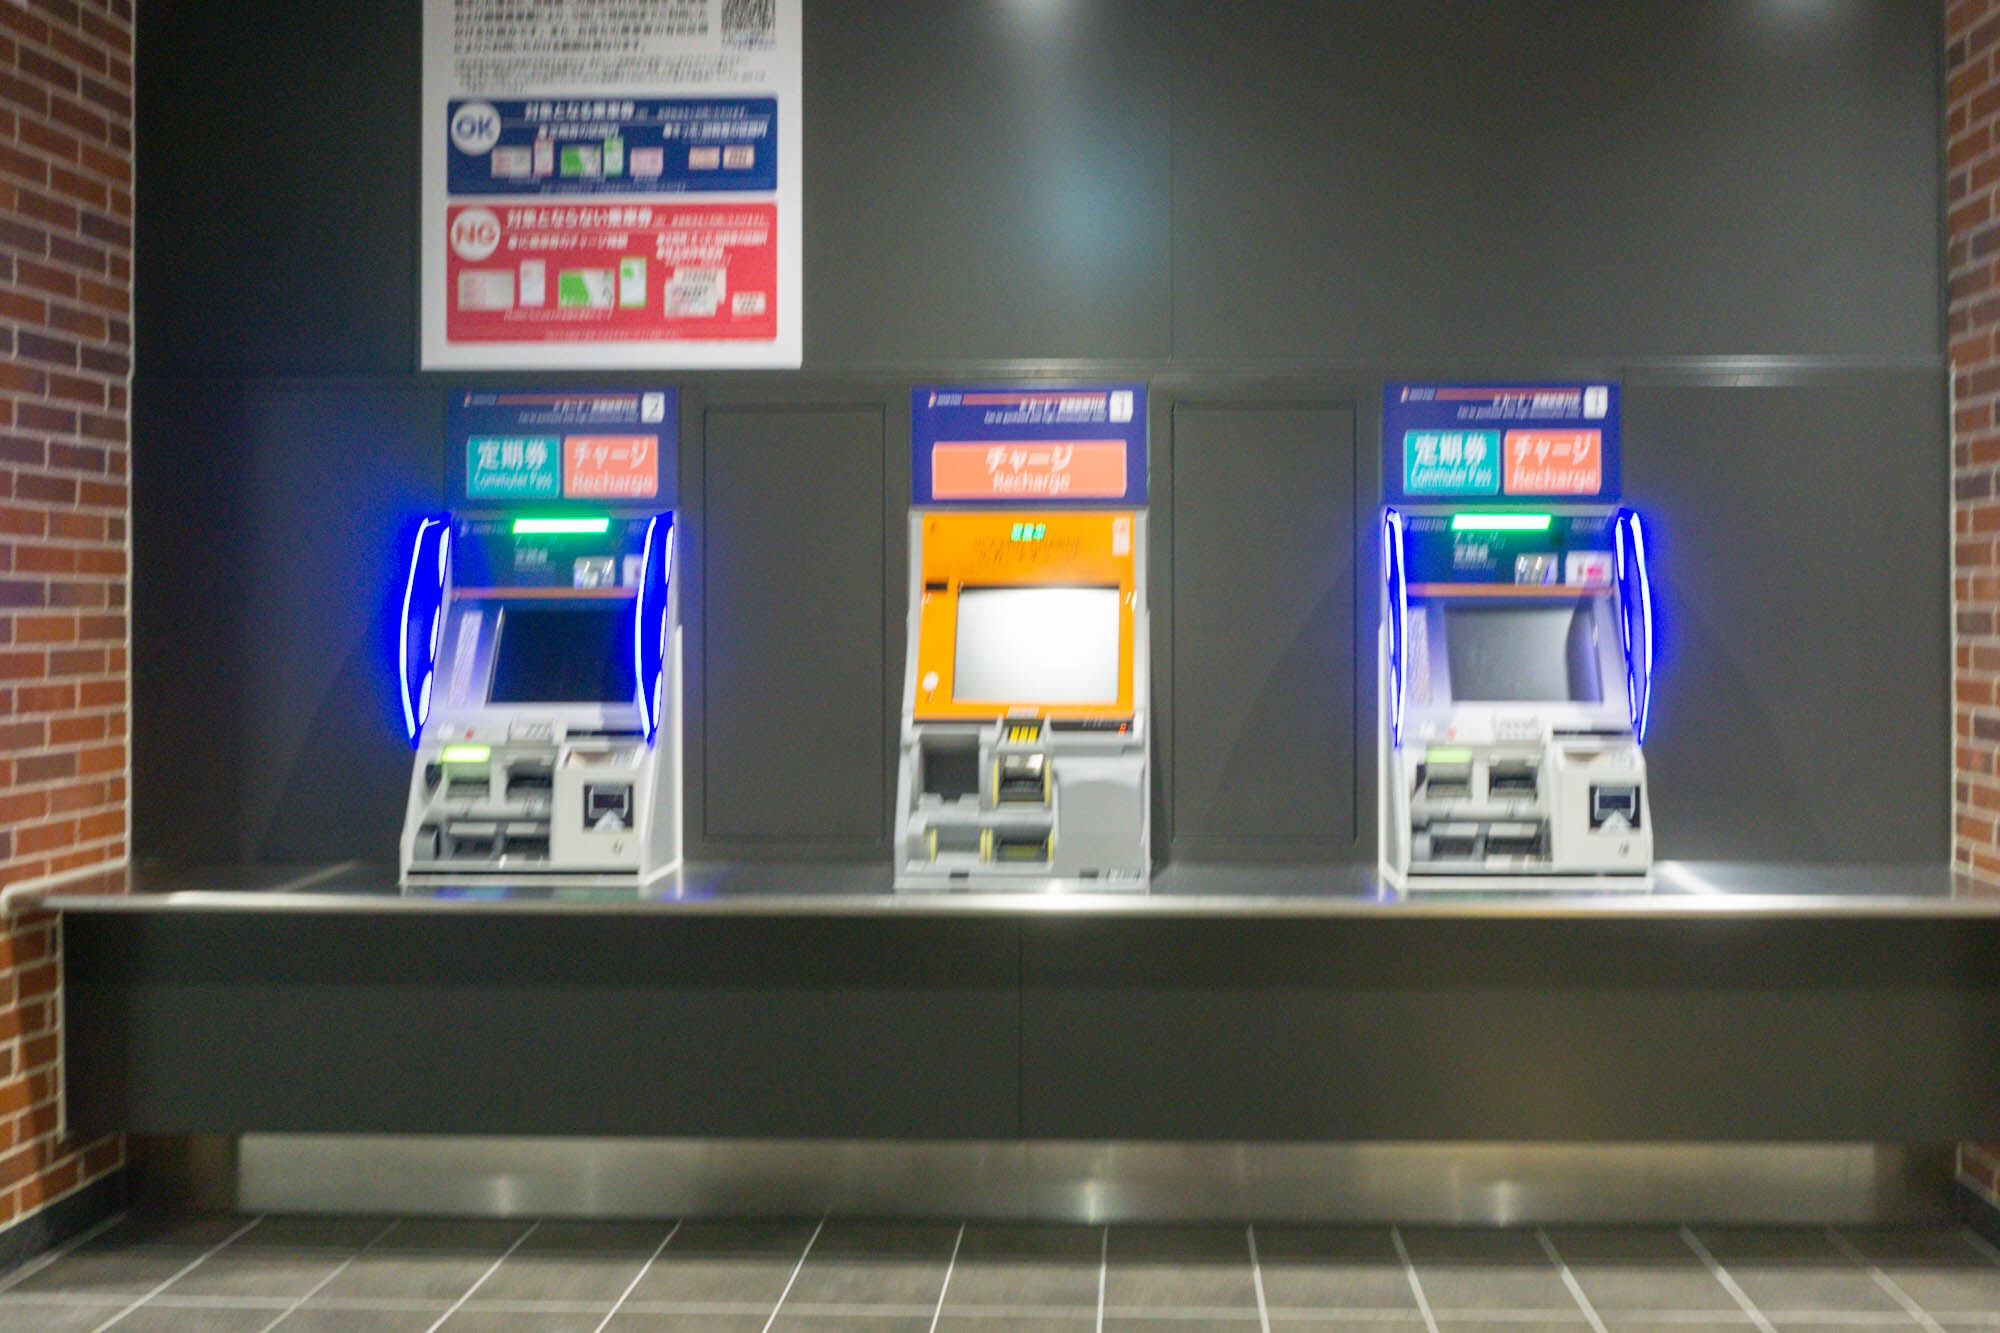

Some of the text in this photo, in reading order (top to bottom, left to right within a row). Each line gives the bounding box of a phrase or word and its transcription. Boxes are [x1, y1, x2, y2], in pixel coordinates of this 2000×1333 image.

[455, 113, 497, 139] OK
[455, 221, 497, 247] NG
[477, 438, 549, 470] 定期券
[573, 439, 649, 469] チャージ
[985, 444, 1075, 472] チャージ
[1414, 432, 1488, 465] 定期券
[1512, 433, 1592, 466] チャージ
[572, 471, 654, 496] Recharge
[992, 471, 1071, 496] Recharge
[1512, 466, 1597, 492] Recharge
